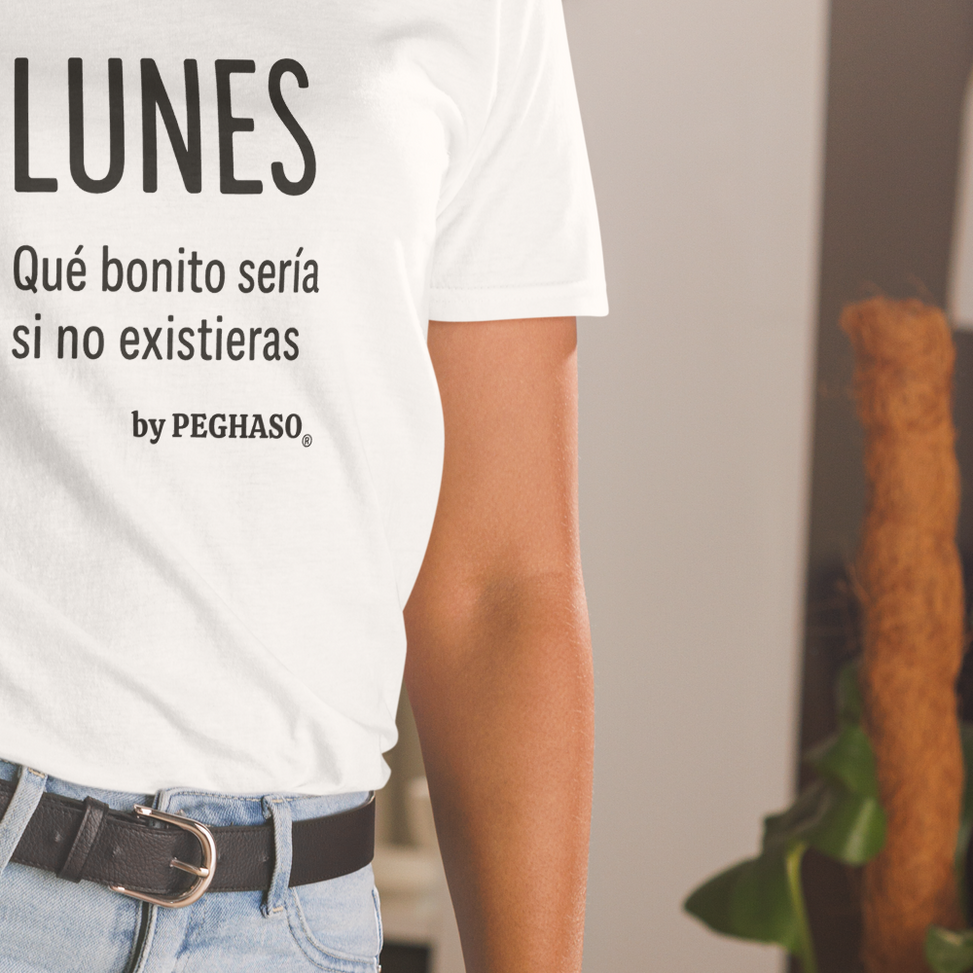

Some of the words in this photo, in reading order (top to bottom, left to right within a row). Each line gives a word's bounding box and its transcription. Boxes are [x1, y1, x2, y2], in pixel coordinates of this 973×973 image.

[14, 57, 317, 196] LUNES
[13, 244, 87, 294] Qué
[101, 245, 226, 294] bonito
[238, 246, 320, 294] sería
[11, 312, 42, 360] si
[57, 325, 105, 360] no
[120, 314, 300, 362] existieras
[131, 410, 167, 445] by
